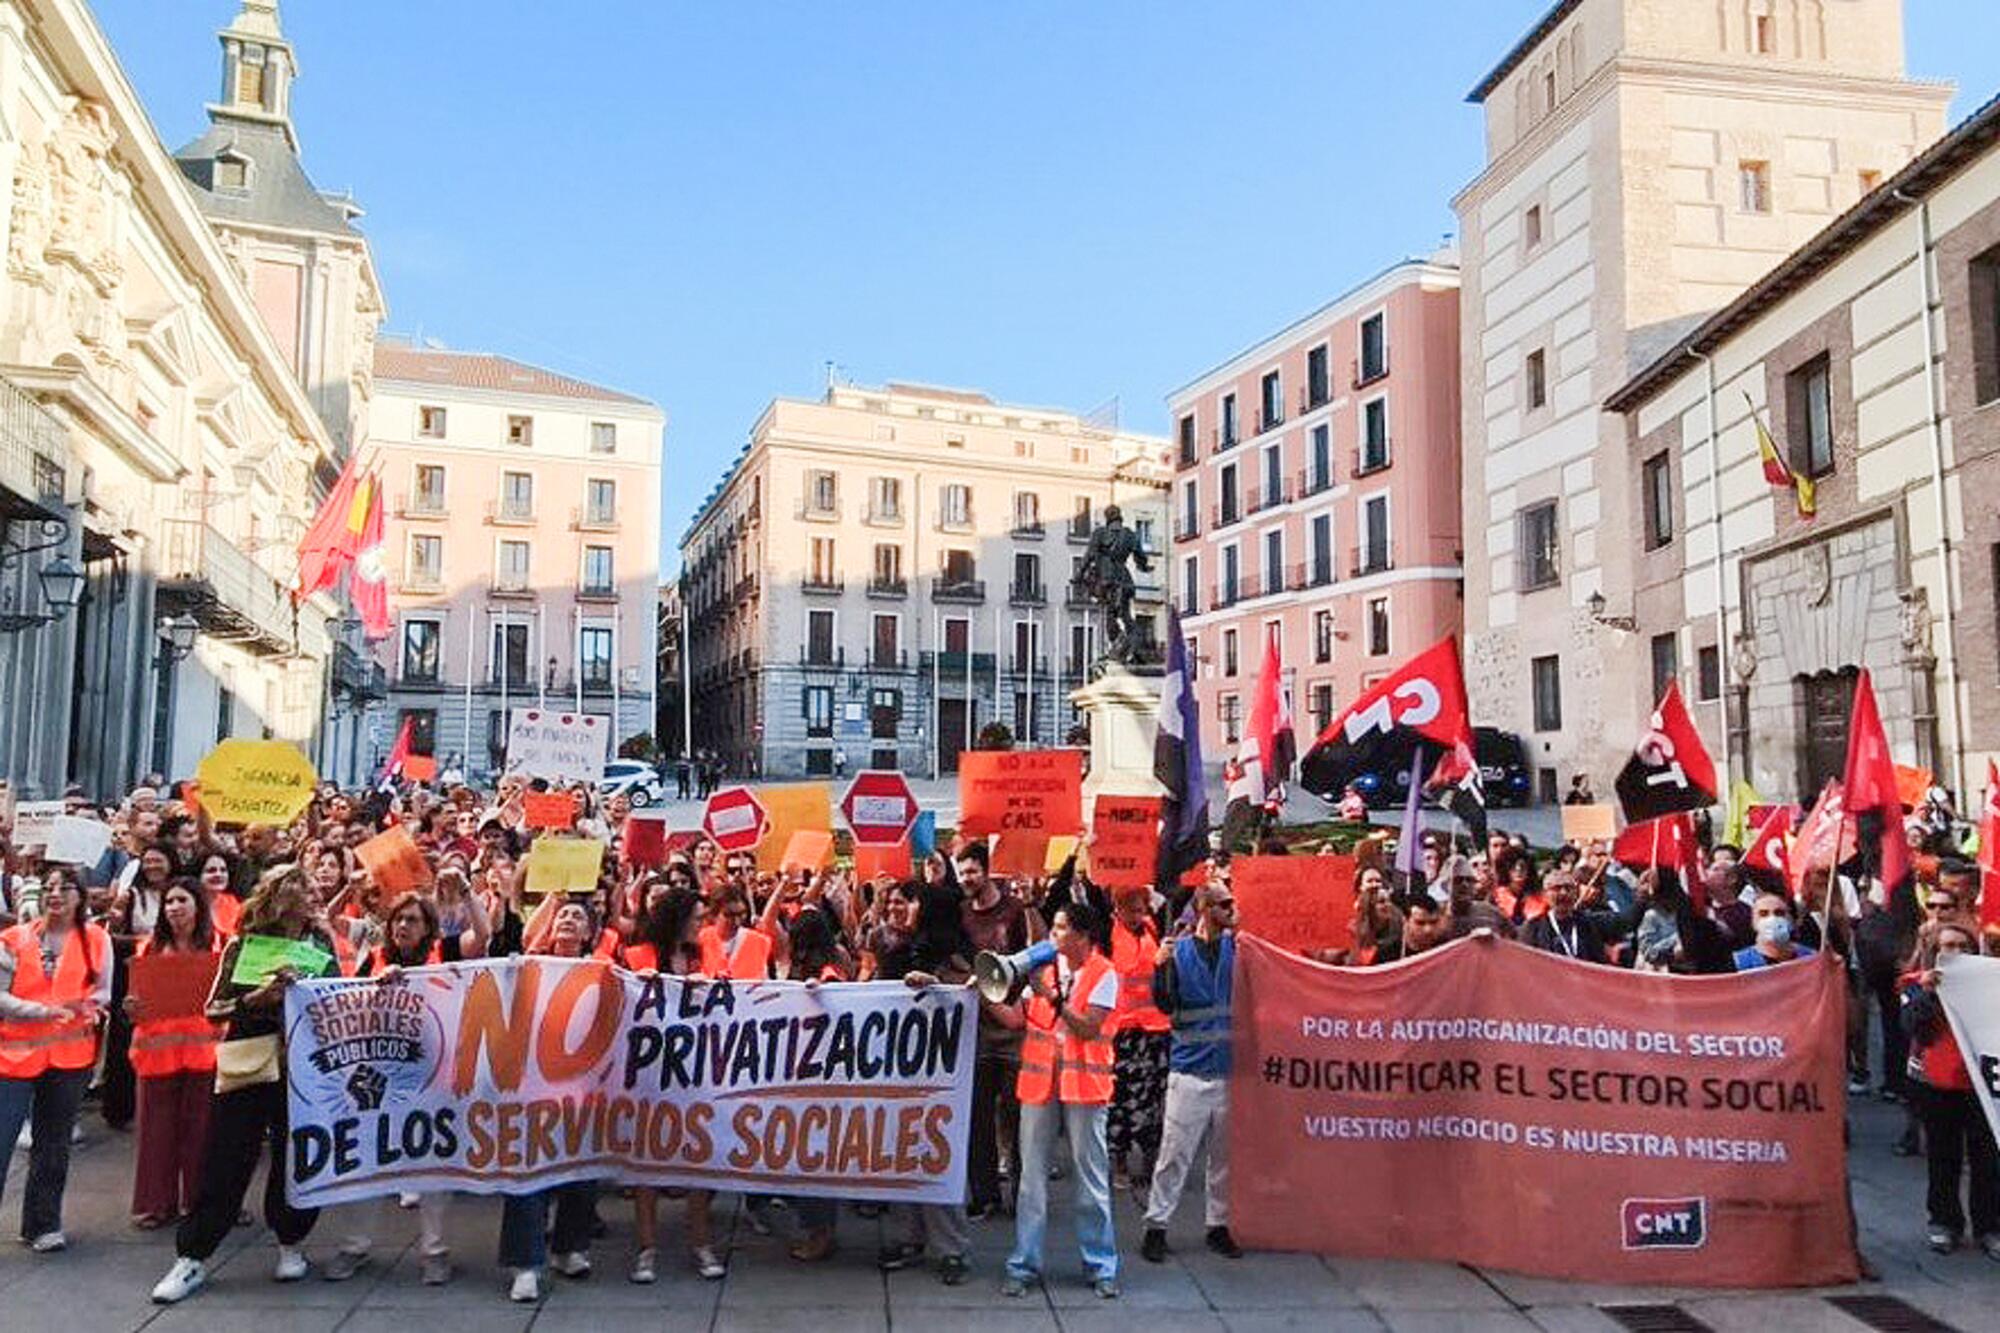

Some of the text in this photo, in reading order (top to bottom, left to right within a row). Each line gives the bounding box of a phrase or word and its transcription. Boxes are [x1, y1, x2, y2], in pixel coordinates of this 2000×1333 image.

[306, 987, 424, 1024] SERVICIOS
[633, 978, 736, 1022] A LA
[312, 1010, 424, 1046] SOCIALES
[452, 961, 626, 1098] NO
[624, 991, 964, 1091] PRIVATIZACIÓN
[1302, 1017, 1785, 1059] POR LA AUTOORGANIZACIÓN DEL SECTOR
[1263, 1056, 1826, 1113] #DIGNIFICAR EL SECTOR SOCIAL
[292, 1091, 954, 1184] DE LOS SERVICIOS SOCIALES
[1305, 1115, 1789, 1163] VUESTRO NEGOCIO ES NUESTRA MISERIA
[1635, 1212, 1691, 1235] CNT
